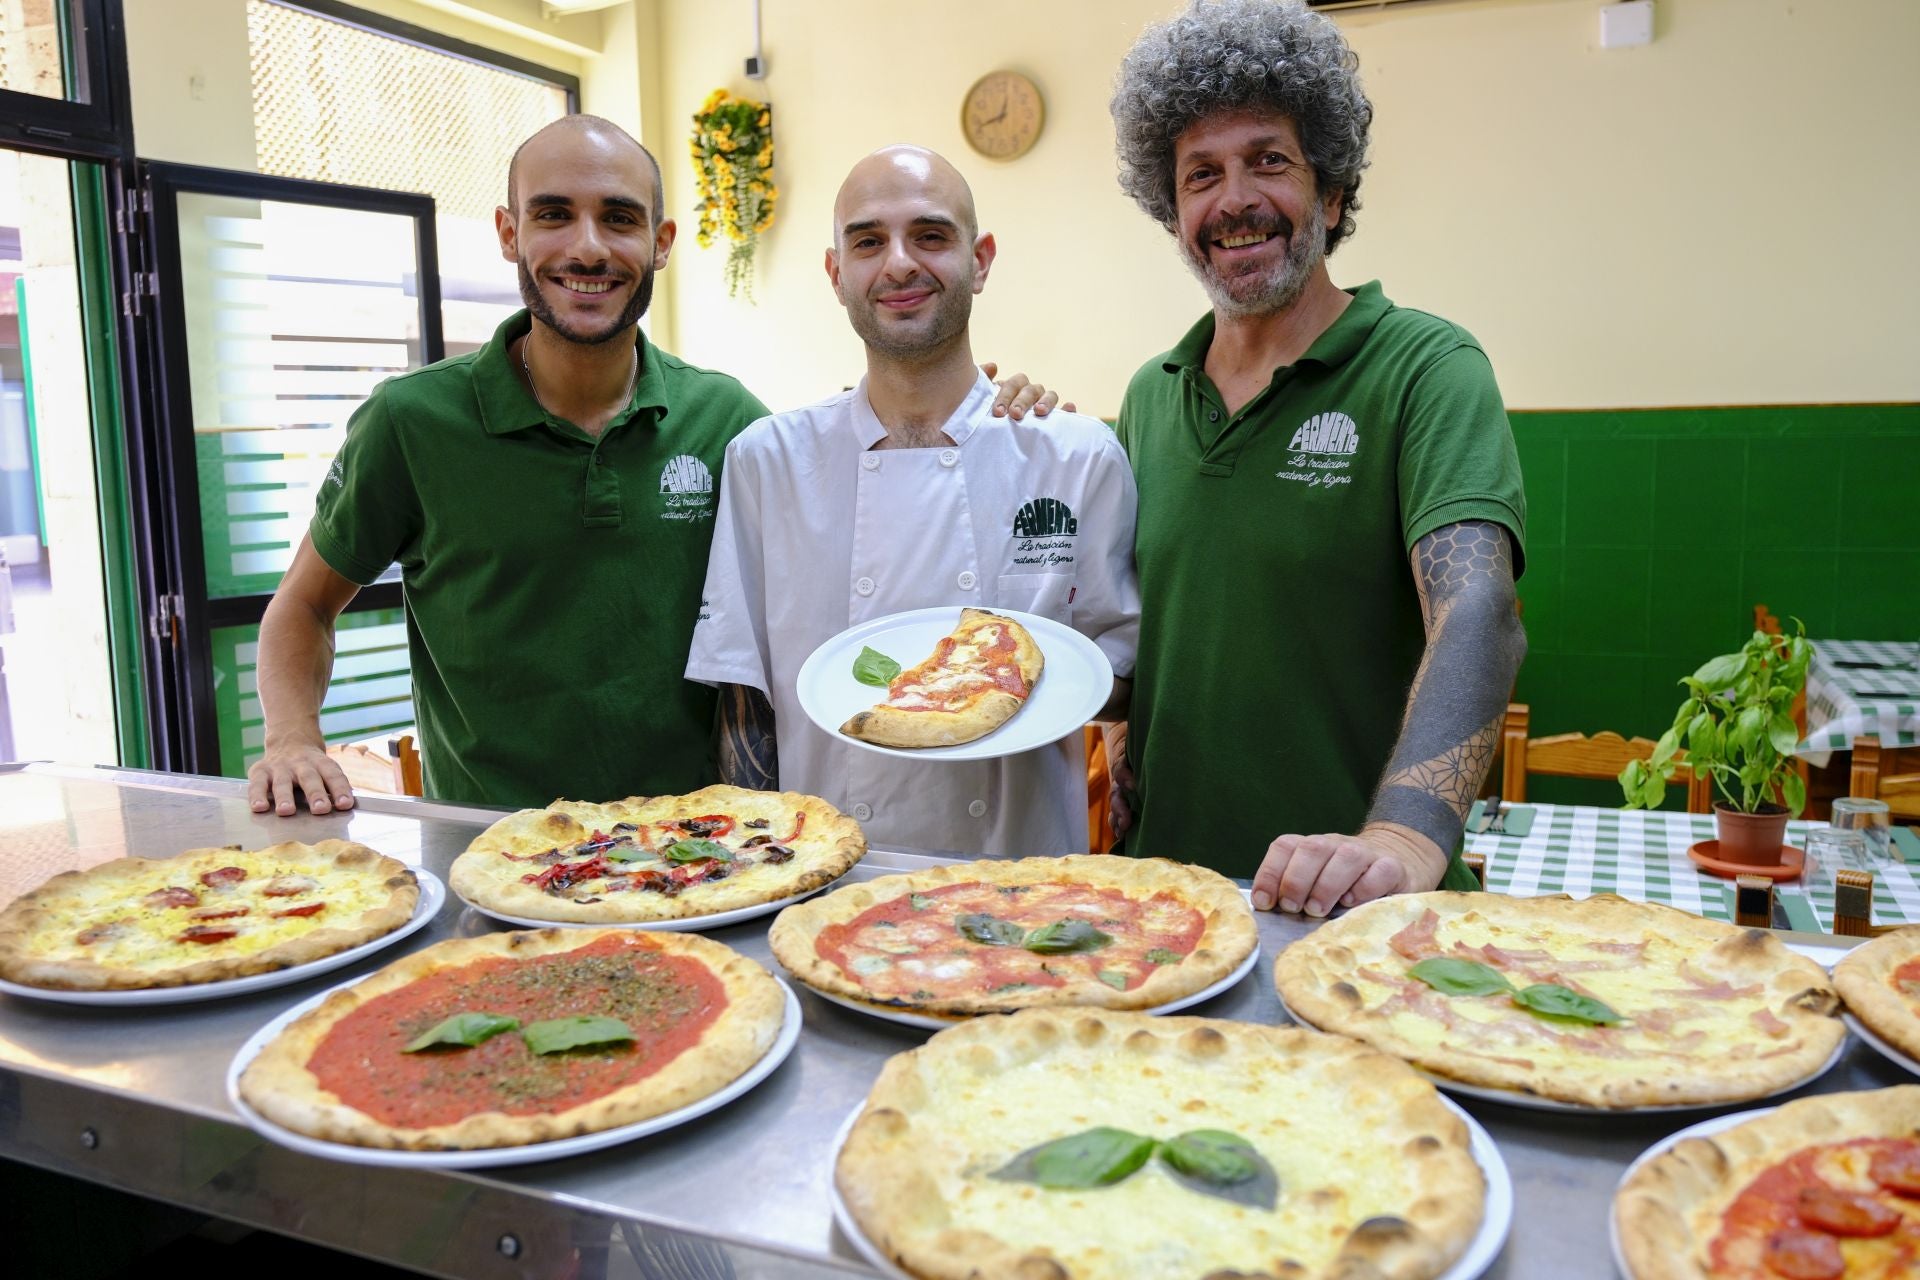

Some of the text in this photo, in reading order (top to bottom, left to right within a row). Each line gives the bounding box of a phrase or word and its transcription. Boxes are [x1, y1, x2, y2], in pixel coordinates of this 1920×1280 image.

[1288, 411, 1359, 453] FERMENTO
[1288, 453, 1307, 468] La
[660, 455, 713, 492] FERMENTO
[1276, 471, 1352, 488] natural y ligera
[665, 494, 681, 507] La
[1013, 498, 1078, 536] FERMENTO
[1018, 539, 1034, 552] La
[1013, 554, 1044, 564] natural
[1048, 552, 1074, 566] ligera
